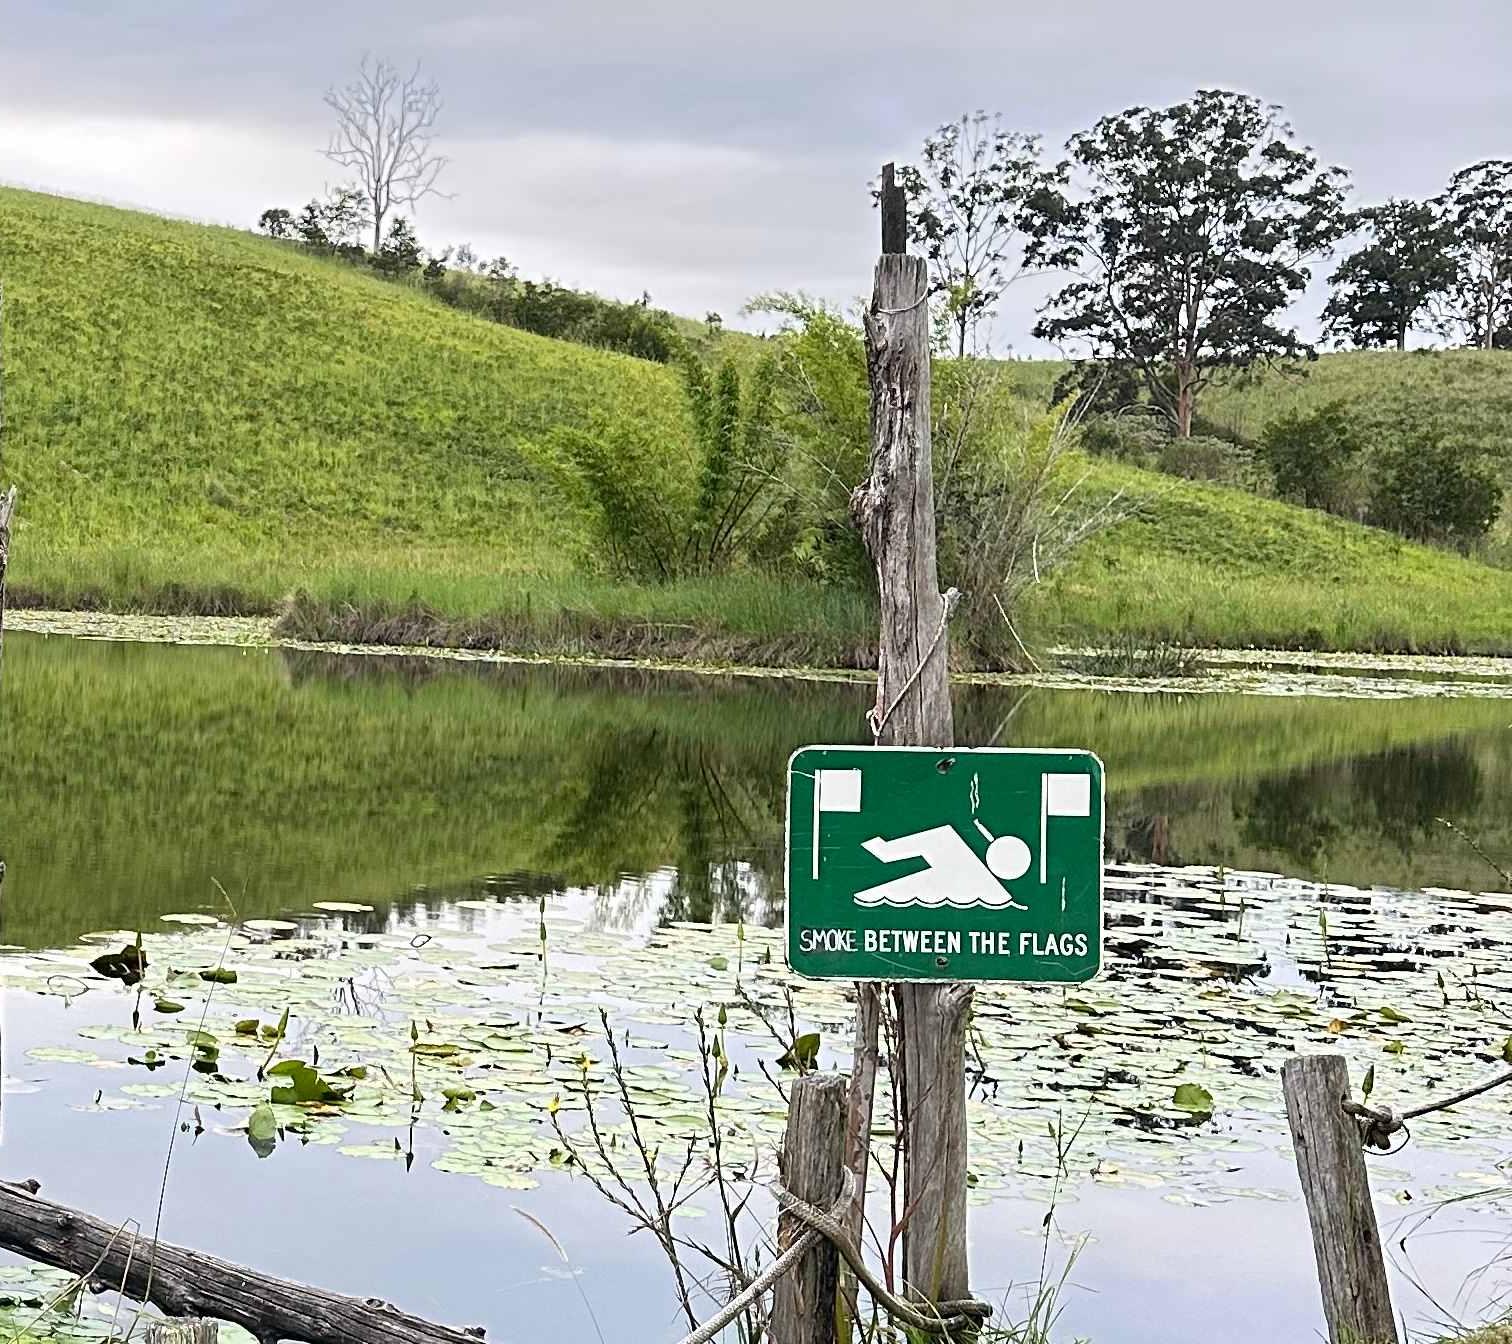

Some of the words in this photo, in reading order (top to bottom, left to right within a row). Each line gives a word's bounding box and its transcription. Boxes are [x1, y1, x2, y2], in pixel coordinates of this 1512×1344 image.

[799, 928, 858, 952] SMOKE
[864, 929, 961, 954] BETWEEN
[968, 931, 1010, 955] THE
[1019, 932, 1088, 956] FLAGS
